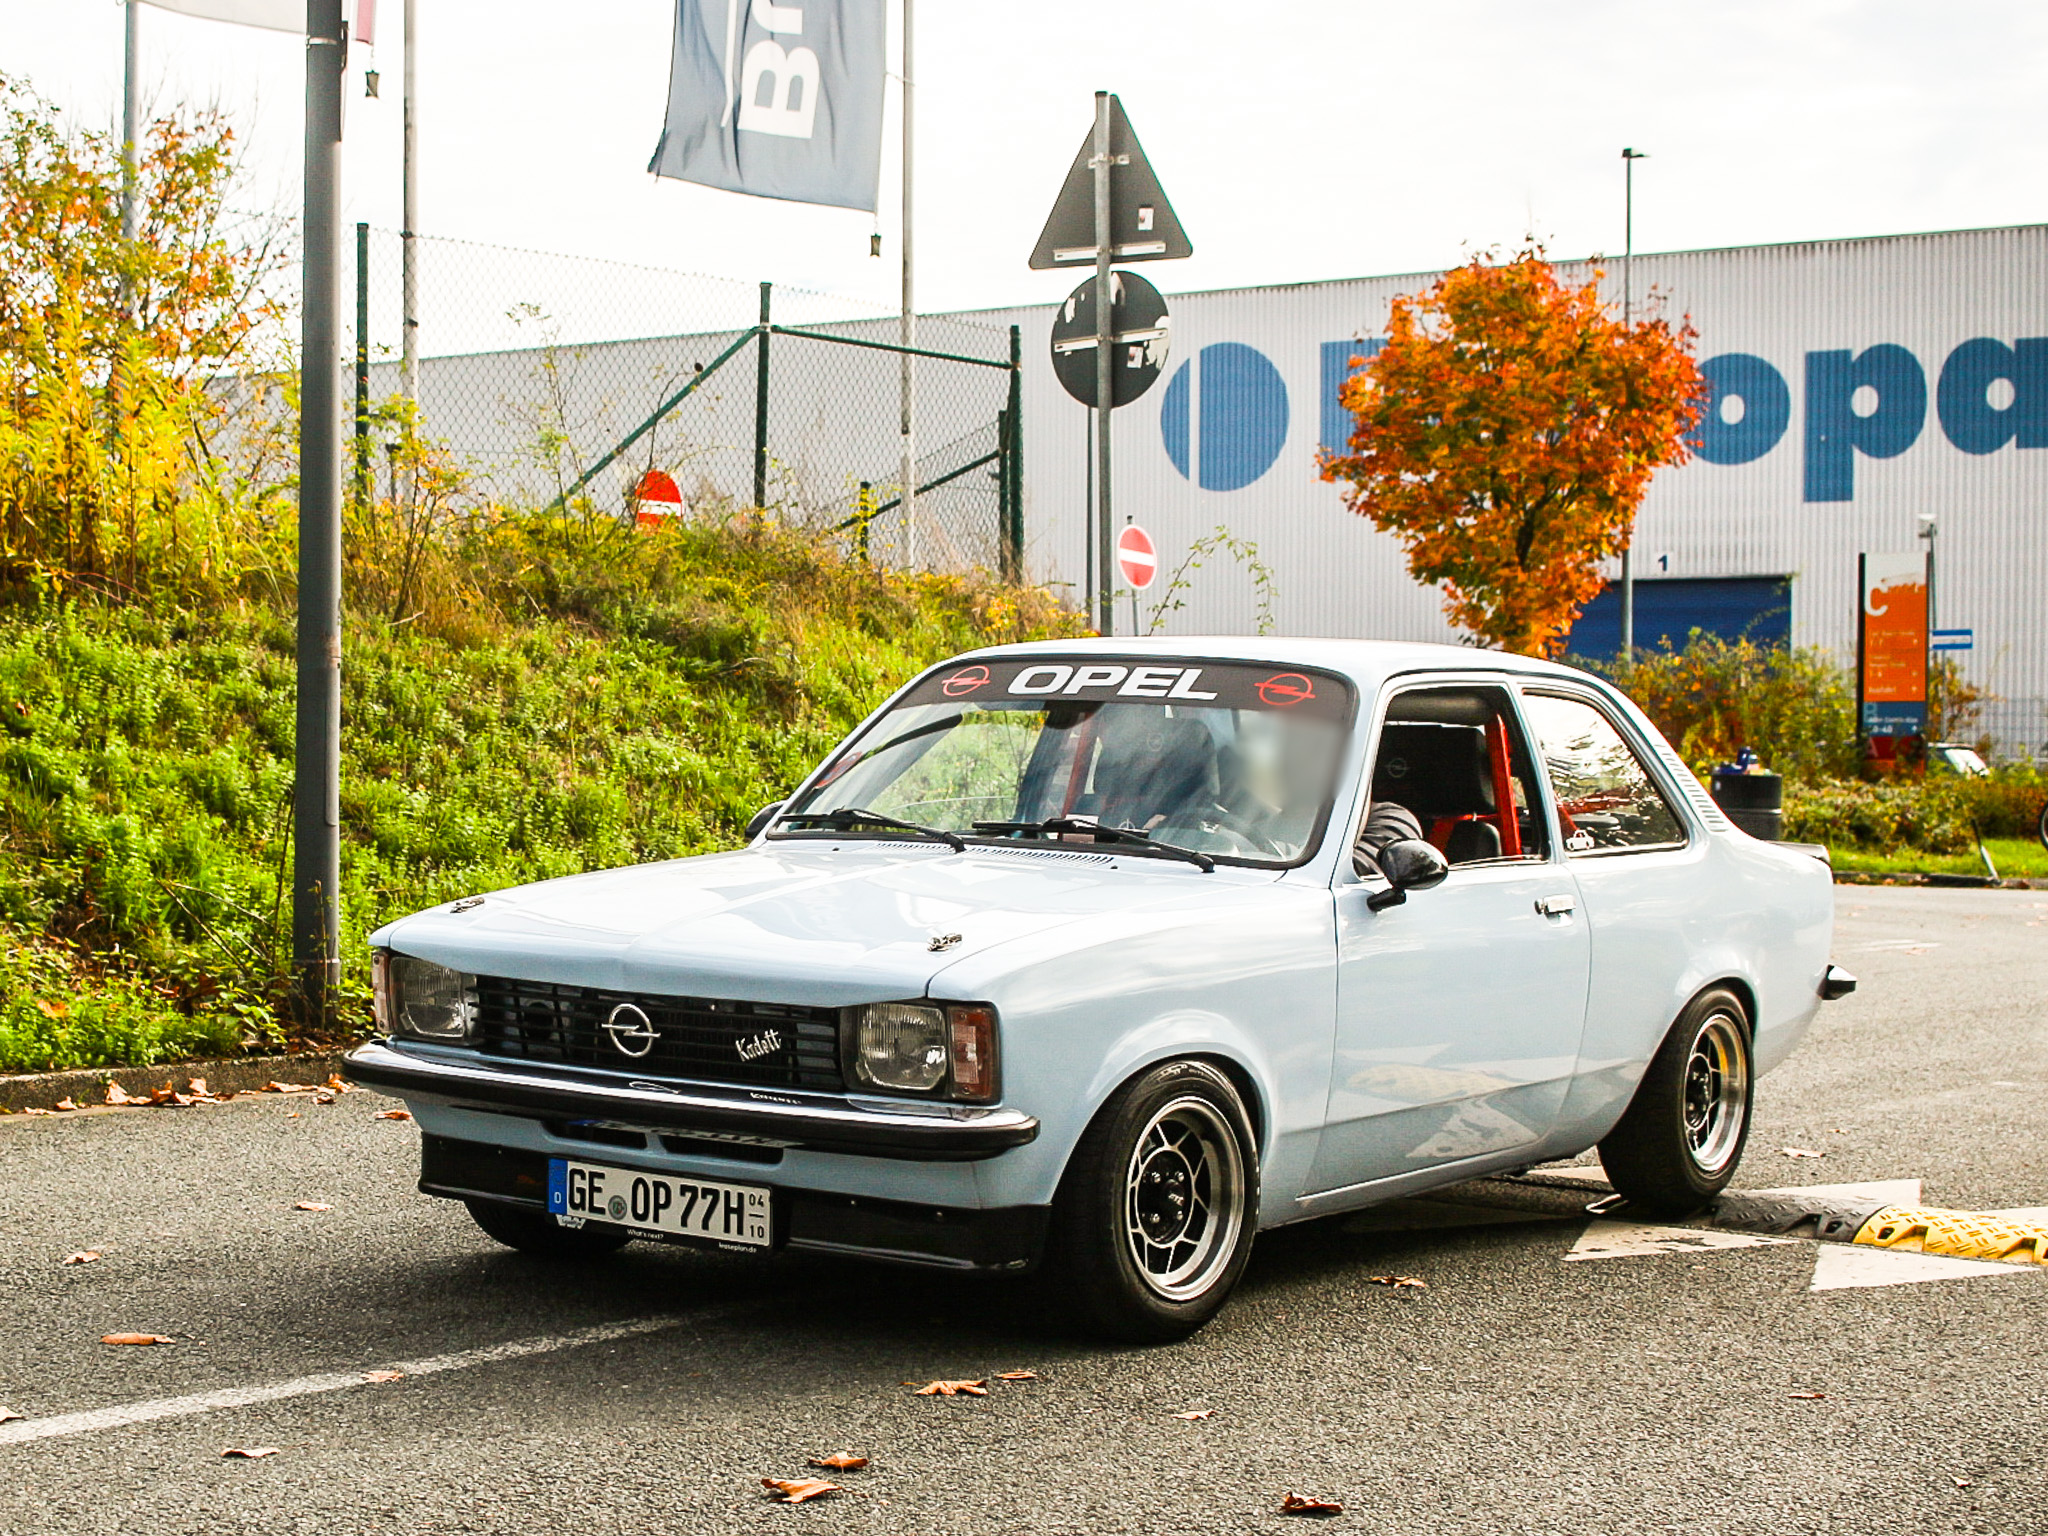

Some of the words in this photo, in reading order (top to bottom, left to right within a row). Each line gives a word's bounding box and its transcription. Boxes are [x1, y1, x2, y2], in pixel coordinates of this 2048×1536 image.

[1657, 553, 1668, 572] 1
[1006, 665, 1218, 700] OPEL
[735, 1028, 782, 1063] Kadett
[568, 1167, 606, 1216] GE
[631, 1176, 672, 1224] OP
[680, 1184, 745, 1236] 77H
[749, 1193, 765, 1208] 04
[750, 1224, 765, 1239] 10
